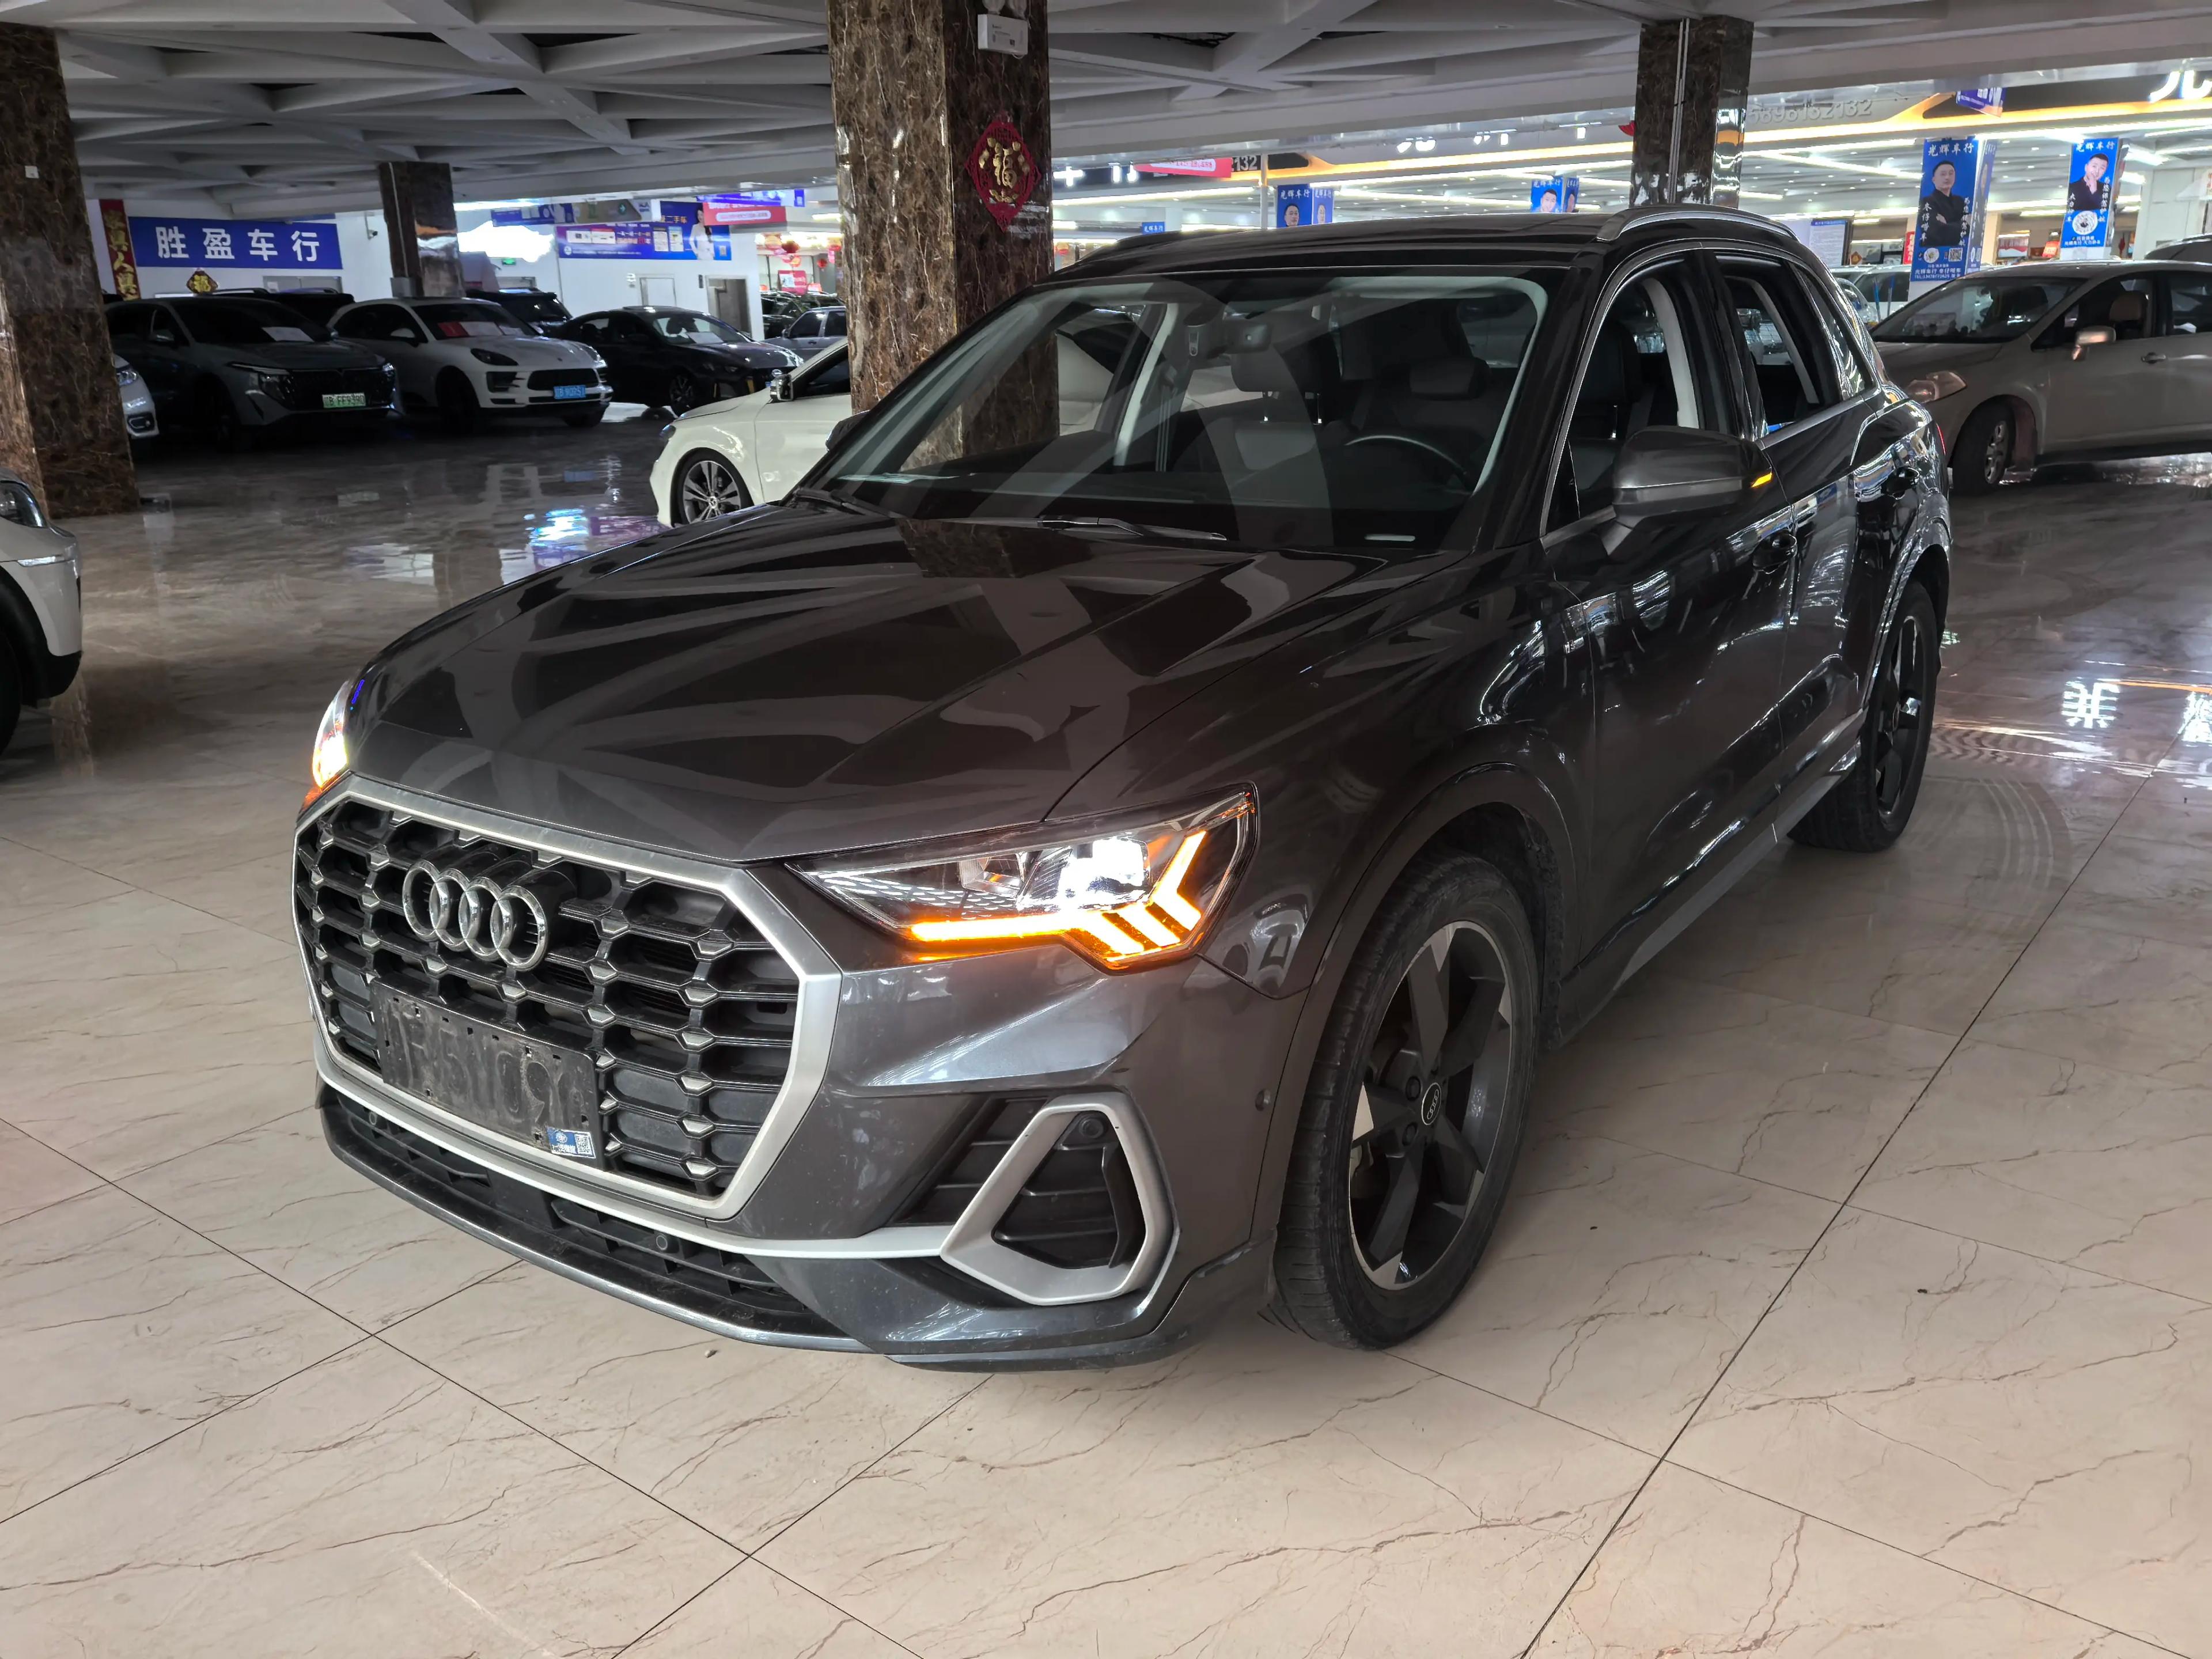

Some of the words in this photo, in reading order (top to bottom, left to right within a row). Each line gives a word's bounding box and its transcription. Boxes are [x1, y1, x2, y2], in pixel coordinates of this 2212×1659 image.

[993, 142, 1017, 189] 福
[1232, 155, 1257, 172] 132
[155, 226, 320, 262] 胜盈车行
